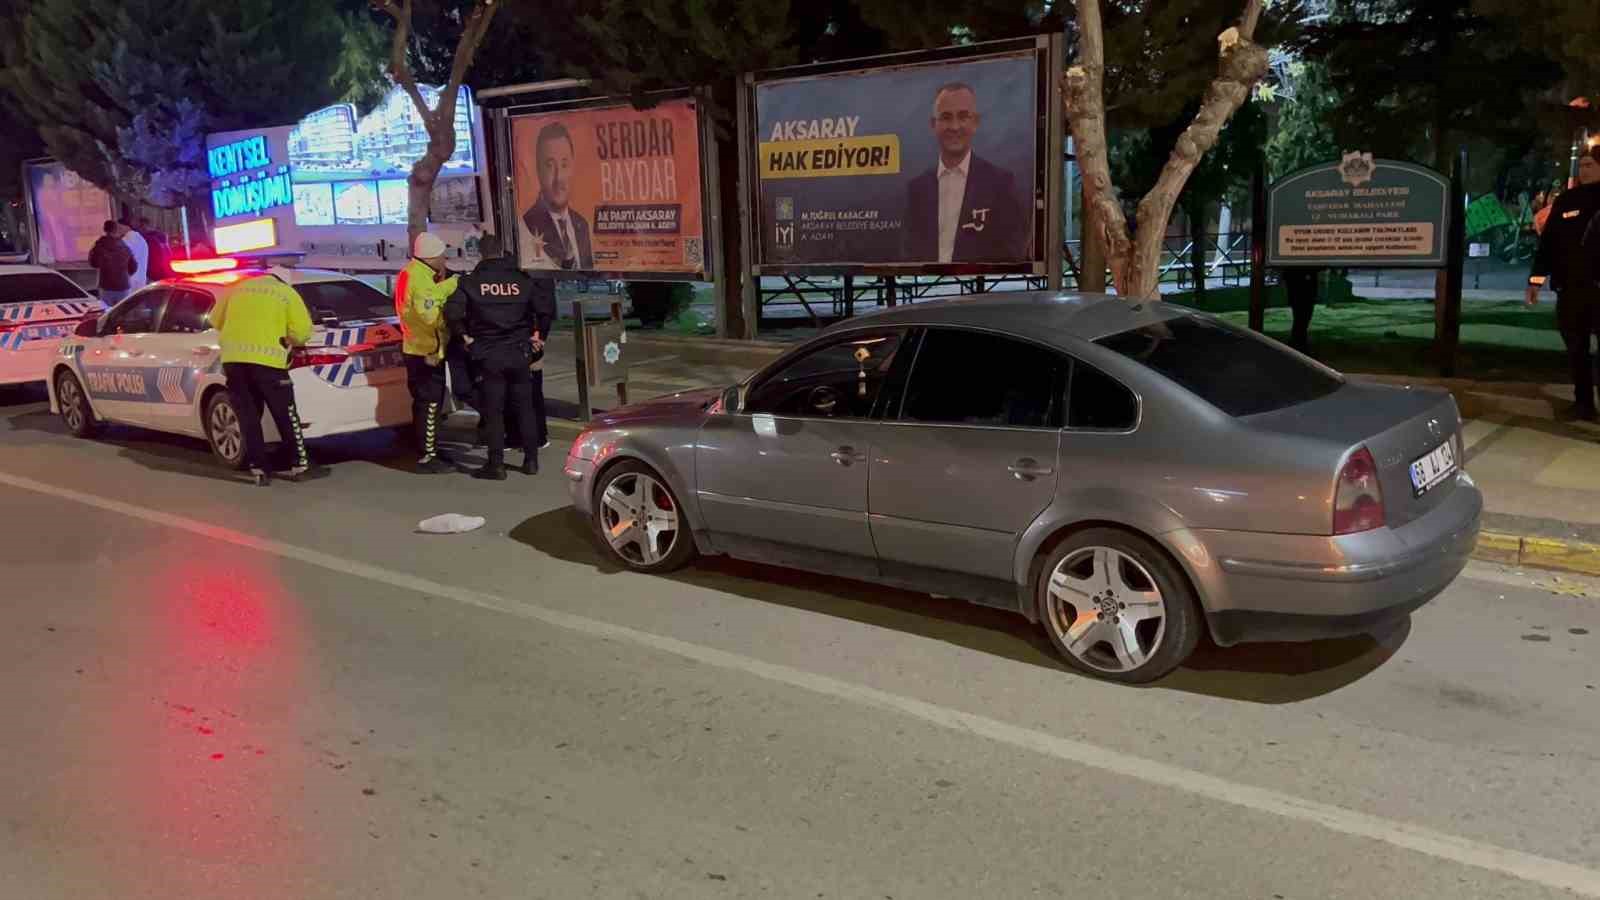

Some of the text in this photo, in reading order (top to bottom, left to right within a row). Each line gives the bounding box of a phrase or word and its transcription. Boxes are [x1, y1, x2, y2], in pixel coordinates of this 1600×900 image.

[596, 118, 674, 160] SERDAR
[770, 115, 860, 142] AKSARAY
[208, 136, 270, 178] KENTSEL
[769, 143, 891, 171] HAK EDİYOR!
[212, 166, 292, 217] DÖNÜŞÜMÜ
[600, 158, 678, 201] BAYDAR
[636, 208, 677, 221] AKSARAY
[775, 222, 794, 245] İYİ
